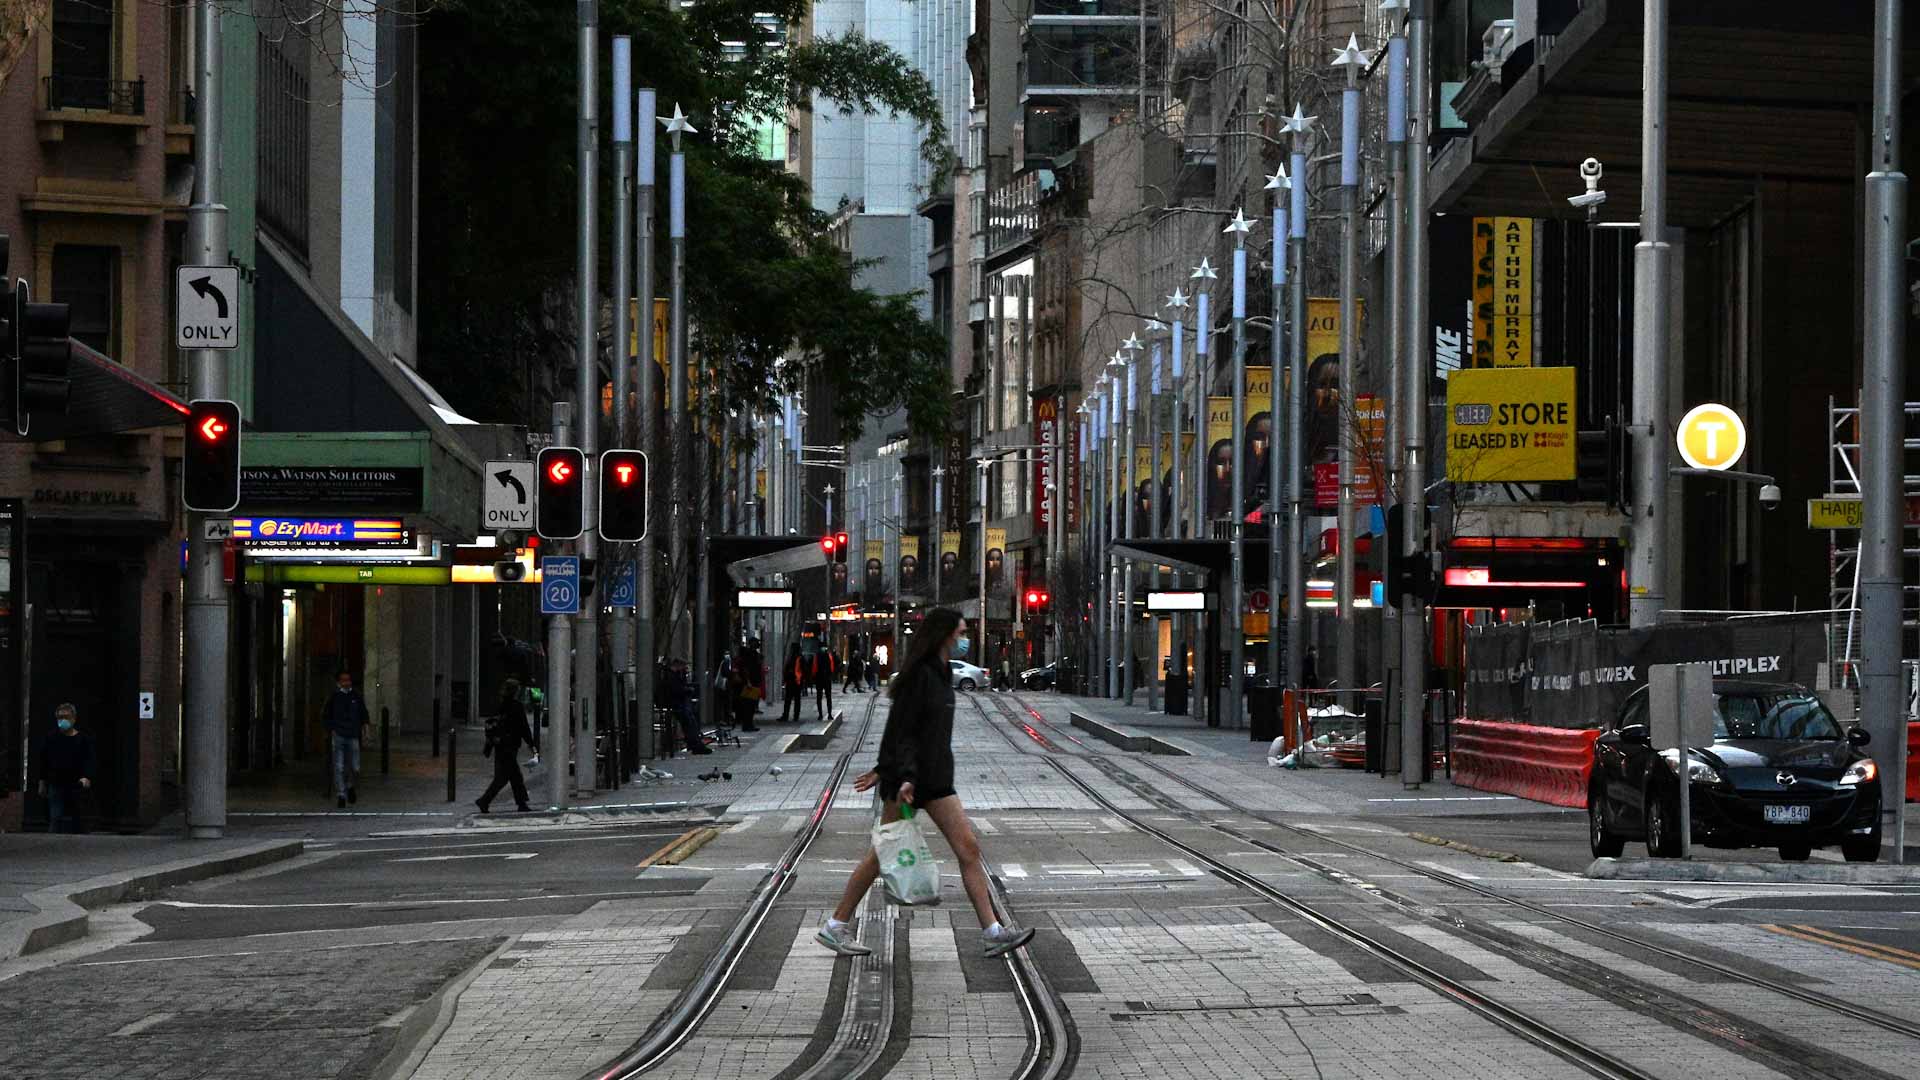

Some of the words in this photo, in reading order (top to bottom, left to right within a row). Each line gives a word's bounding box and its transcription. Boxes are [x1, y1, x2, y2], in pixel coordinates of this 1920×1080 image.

[1505, 222, 1520, 289] ARTHUR
[182, 326, 233, 340] ONLY
[1505, 294, 1520, 361] MURRAY
[1498, 403, 1569, 425] STORE
[1453, 433, 1507, 450] LEASED
[1510, 432, 1529, 449] BY
[1696, 421, 1727, 461] T
[240, 470, 271, 480] TSON
[280, 468, 327, 480] WATSON
[328, 468, 396, 481] SOLICITORS
[488, 510, 529, 522] ONLY
[277, 521, 343, 538] EzyMart
[359, 570, 373, 578] TAB
[550, 586, 570, 603] 20
[1791, 807, 1809, 818] 840
